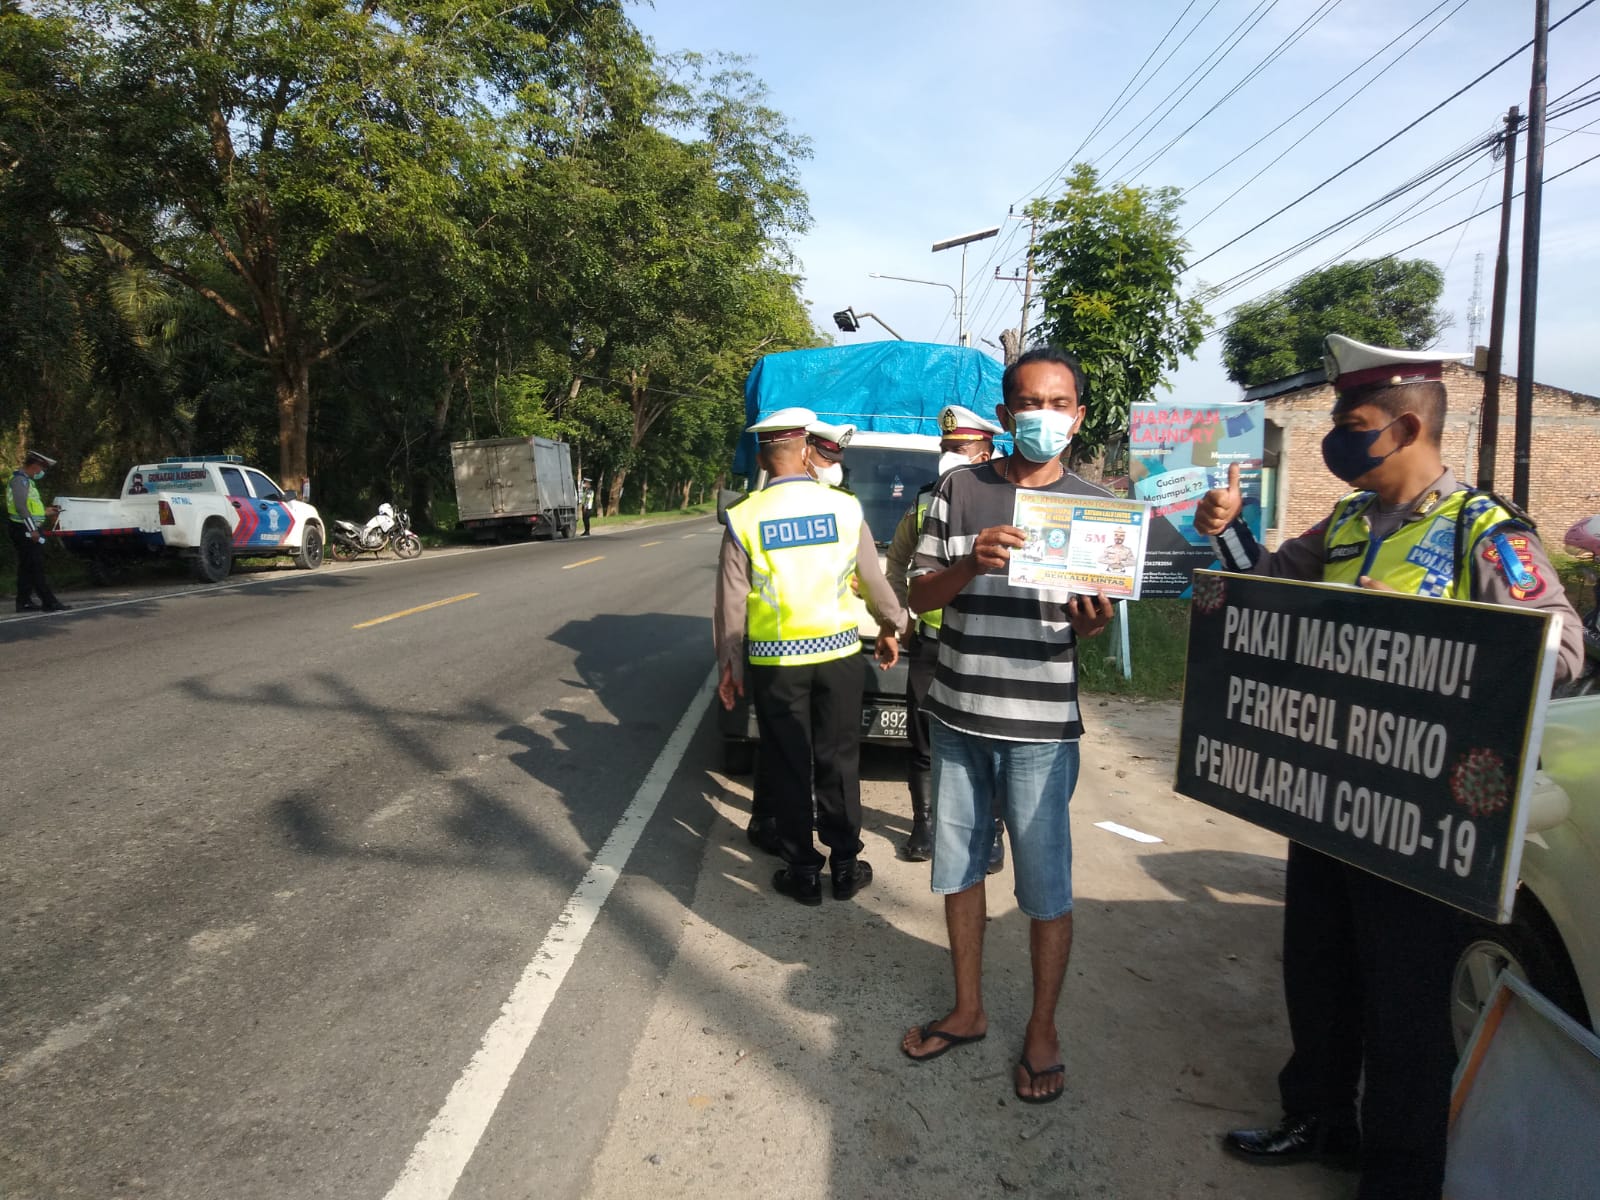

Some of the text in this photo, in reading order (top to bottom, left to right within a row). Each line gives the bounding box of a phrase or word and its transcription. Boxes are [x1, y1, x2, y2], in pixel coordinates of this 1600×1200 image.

[1132, 409, 1220, 425] HARAPAN
[1132, 428, 1215, 444] LAUNDRY
[1156, 476, 1186, 488] Cucian
[1143, 486, 1191, 502] Menumpuk
[764, 517, 836, 547] POLISI
[1084, 533, 1107, 544] 5M
[1091, 578, 1125, 586] LINTAS
[1223, 606, 1477, 699] PAKAI MASKERMU!
[1226, 675, 1448, 780] PERKECIL RISIKO
[1195, 734, 1477, 878] PENULARAN COVID-19
